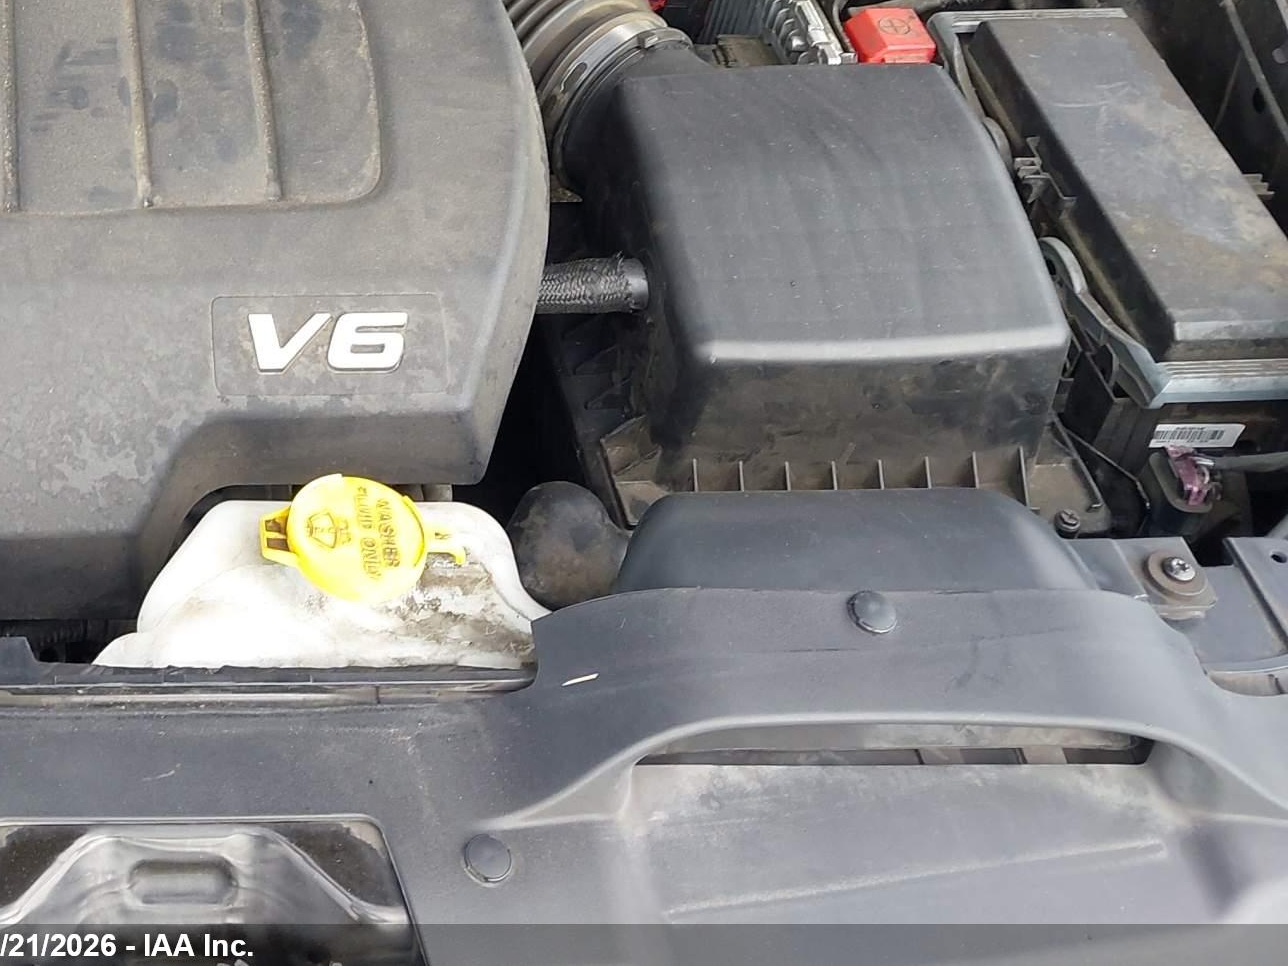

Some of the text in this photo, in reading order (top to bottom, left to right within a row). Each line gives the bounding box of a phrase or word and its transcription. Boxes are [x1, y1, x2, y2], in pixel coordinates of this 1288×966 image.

[248, 312, 409, 371] V6
[354, 486, 383, 580] FLUID ONLY
[377, 498, 401, 567] WASHER
